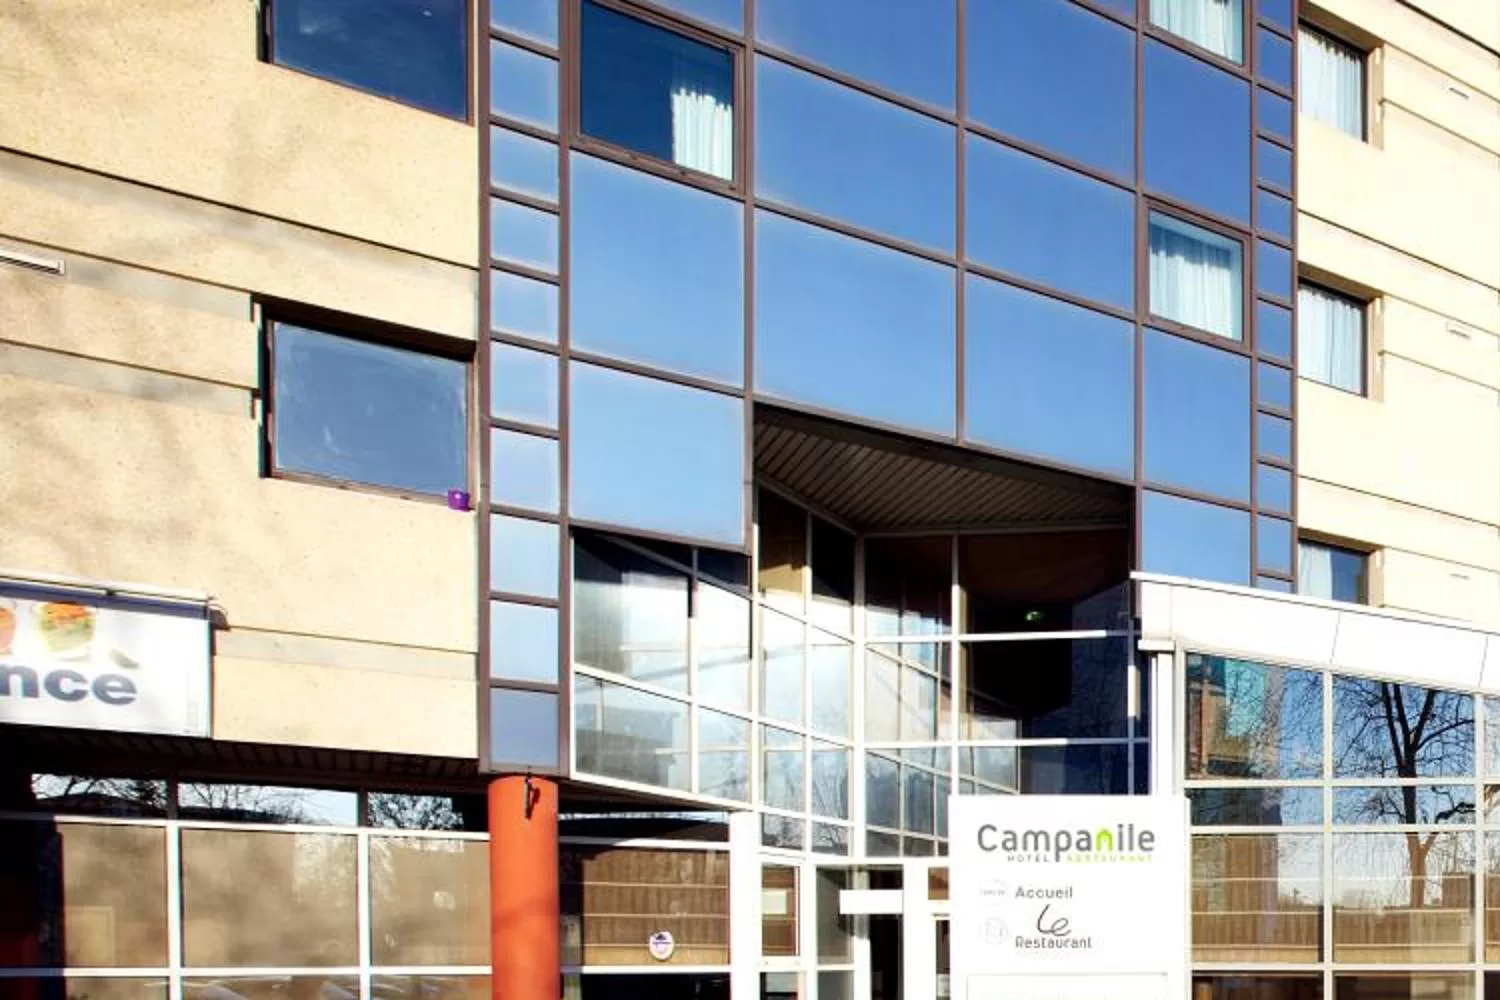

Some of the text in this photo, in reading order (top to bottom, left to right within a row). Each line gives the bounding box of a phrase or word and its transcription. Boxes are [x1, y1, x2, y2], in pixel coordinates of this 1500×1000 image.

[977, 824, 1155, 862] Campanile
[1015, 886, 1073, 899] Accueil
[1036, 904, 1072, 937] Le
[1015, 936, 1092, 949] Restaurant
